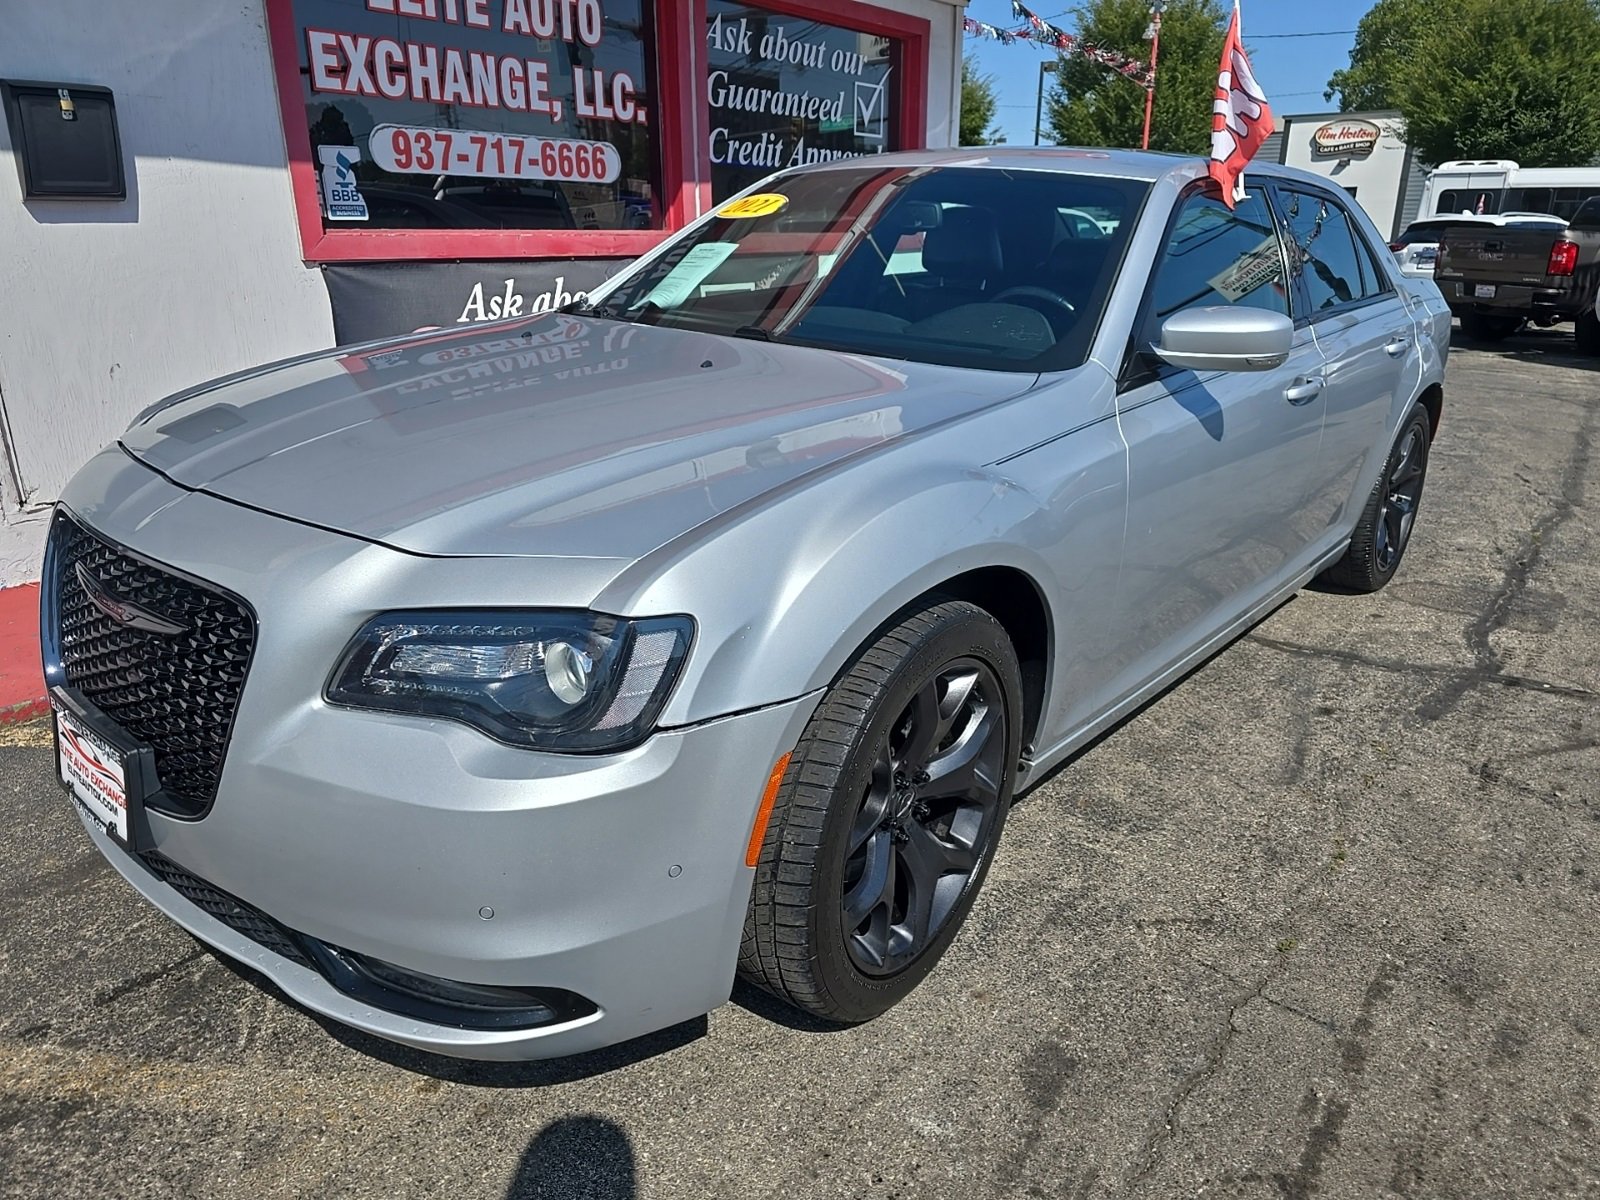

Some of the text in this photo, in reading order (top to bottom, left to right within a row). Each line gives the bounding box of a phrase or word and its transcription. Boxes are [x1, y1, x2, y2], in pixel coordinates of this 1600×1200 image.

[503, 0, 602, 46] AUTO
[706, 13, 868, 76] Ask about our
[307, 28, 648, 125] EXCHANGE, LLC.
[707, 71, 844, 122] Guaranteed
[391, 131, 606, 179] 937-717-6666
[709, 127, 883, 168] Credit Appro
[1319, 126, 1377, 140] Tim Hortons
[333, 190, 360, 201] BBB
[456, 282, 523, 323] Ask
[531, 276, 588, 313] abo
[73, 755, 90, 778] AUTO
[91, 771, 128, 810] EXCHANGE
